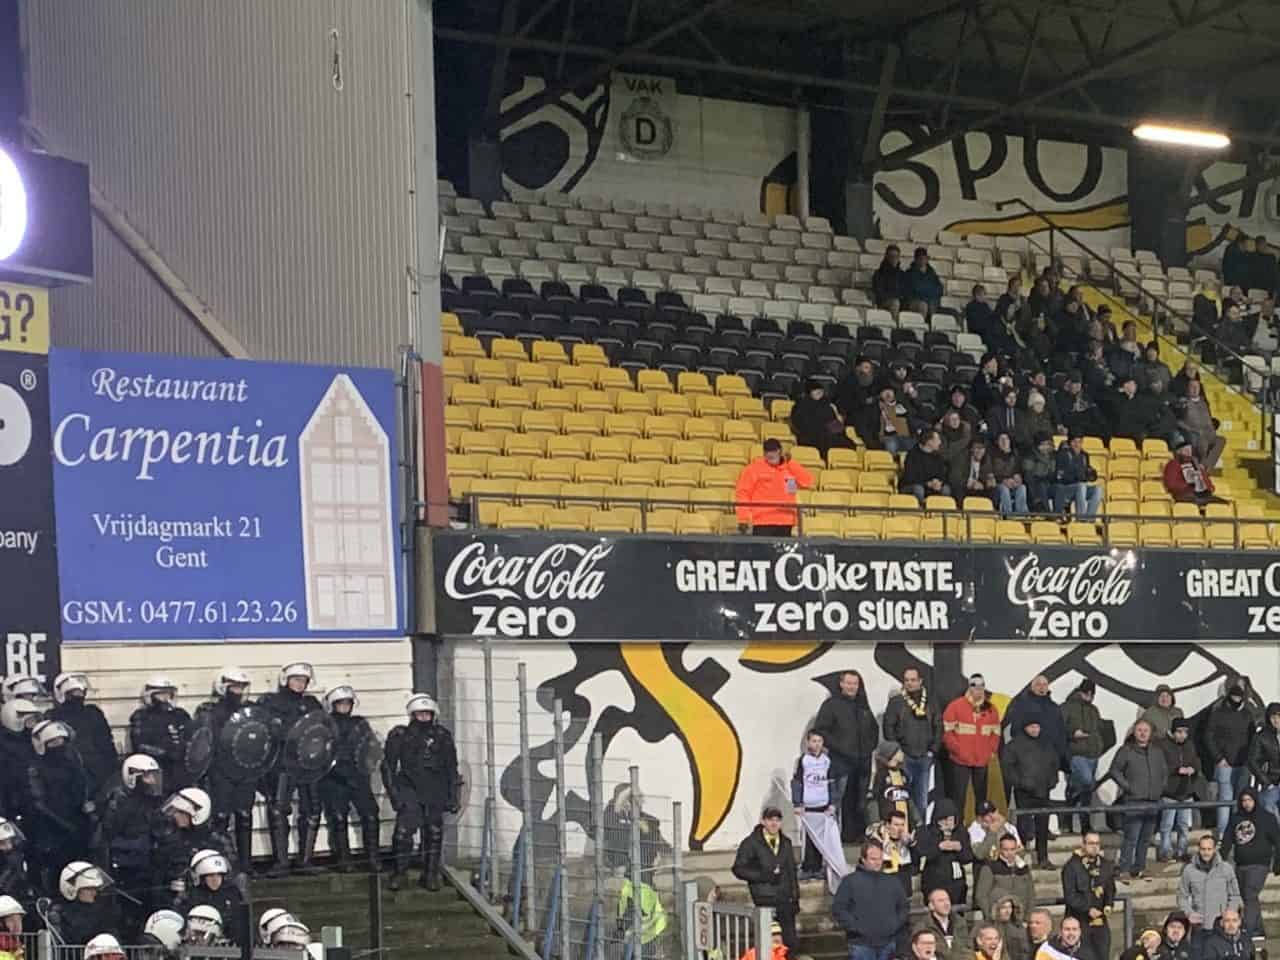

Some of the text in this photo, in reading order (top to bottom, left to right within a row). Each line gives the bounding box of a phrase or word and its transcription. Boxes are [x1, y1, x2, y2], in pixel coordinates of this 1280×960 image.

[624, 78, 663, 95] VAK
[92, 367, 248, 402] Restaurant
[53, 412, 289, 481] Carpentia
[93, 513, 262, 543] Vrijdagmarkt 21
[156, 545, 208, 568] Gent
[445, 542, 612, 600] Coca-Cola
[676, 552, 963, 599] GREAT Coke TASTE,
[1006, 554, 1132, 607] Coca-Cola
[1186, 568, 1261, 598] GREAT
[63, 600, 297, 624] GSM: 0477.61.23.26
[472, 606, 576, 637] zero
[753, 600, 949, 633] zero SUGAR
[1028, 607, 1108, 639] zero
